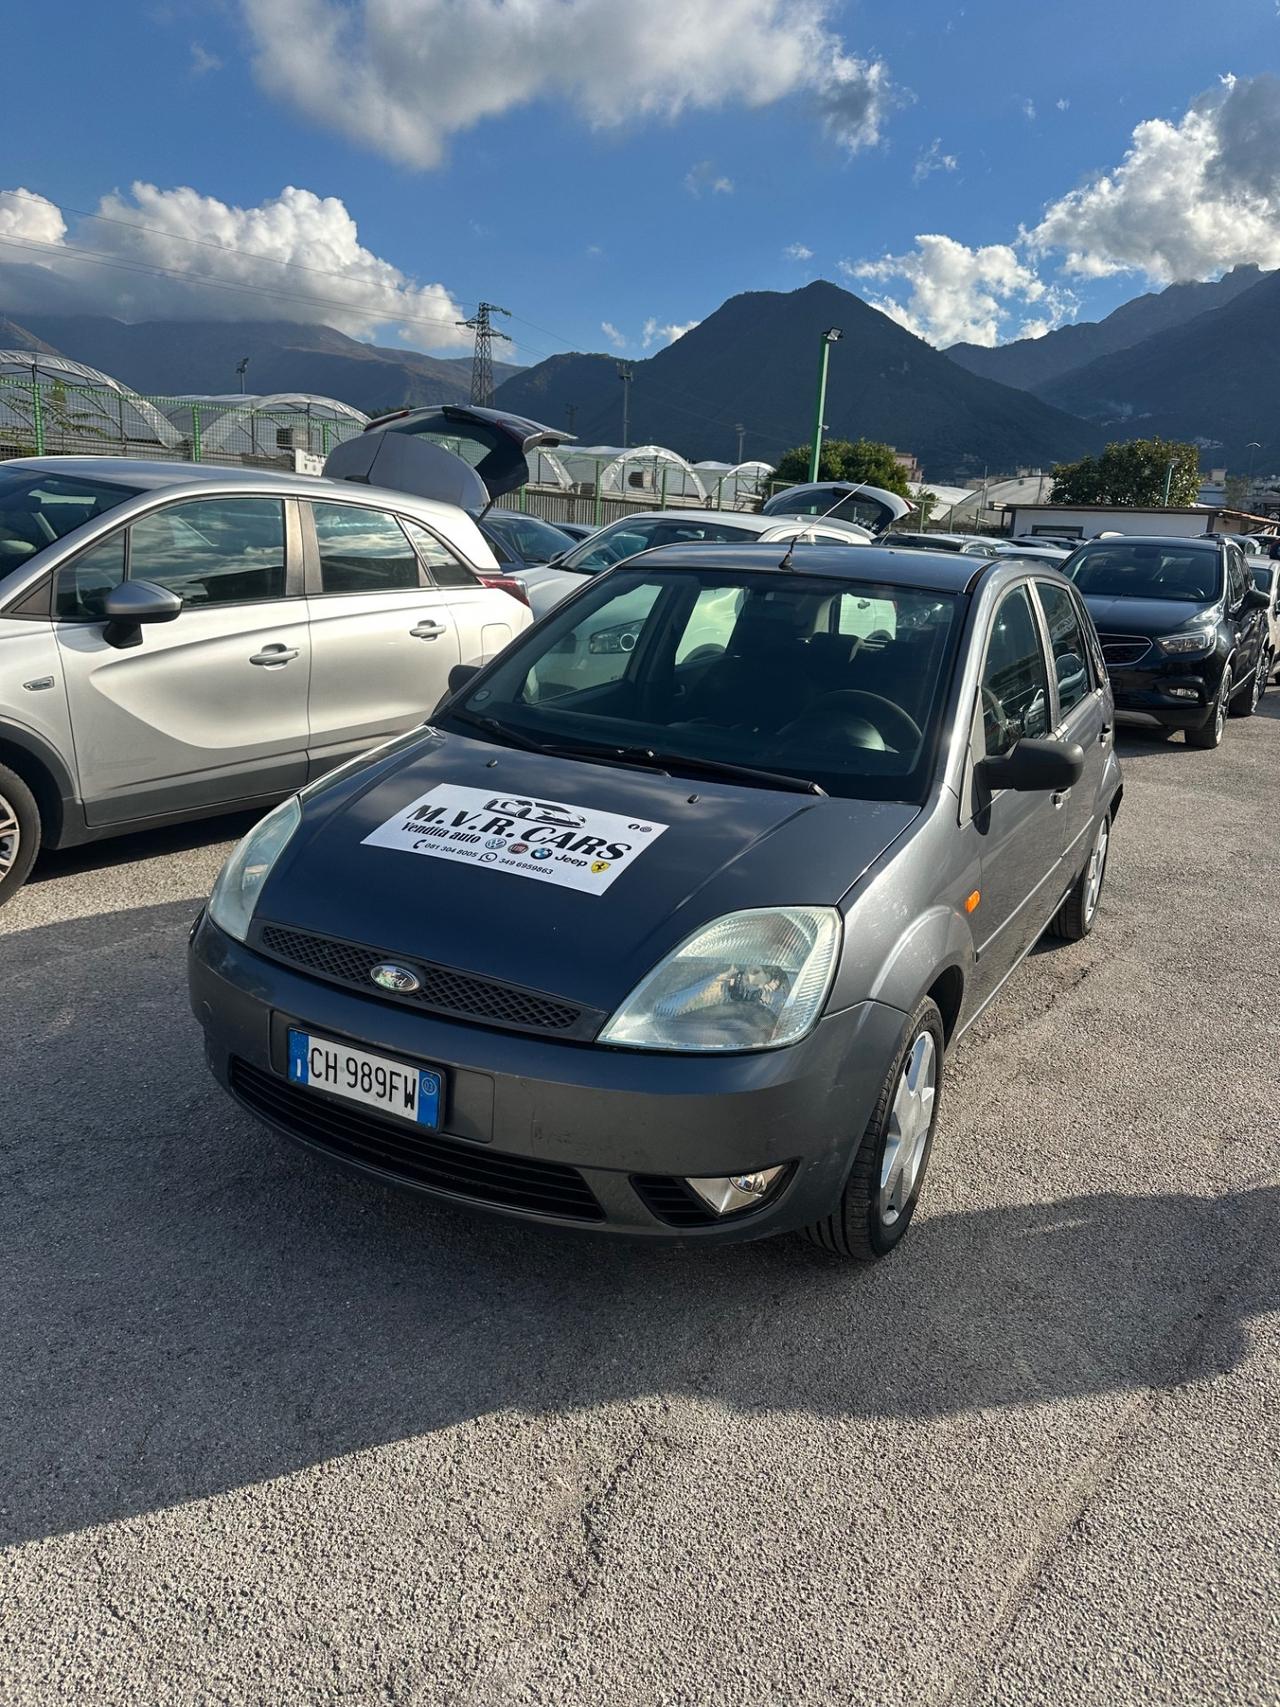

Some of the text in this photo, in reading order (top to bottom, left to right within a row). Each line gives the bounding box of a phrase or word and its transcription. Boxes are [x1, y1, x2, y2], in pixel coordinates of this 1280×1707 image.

[401, 822, 482, 844] Vendita auto
[424, 842, 440, 850] 081
[456, 850, 479, 858] 8005
[499, 858, 553, 874] 349 6959863
[555, 854, 588, 867] Jeep
[311, 1047, 338, 1084] CH
[346, 1057, 416, 1110] 989FW
